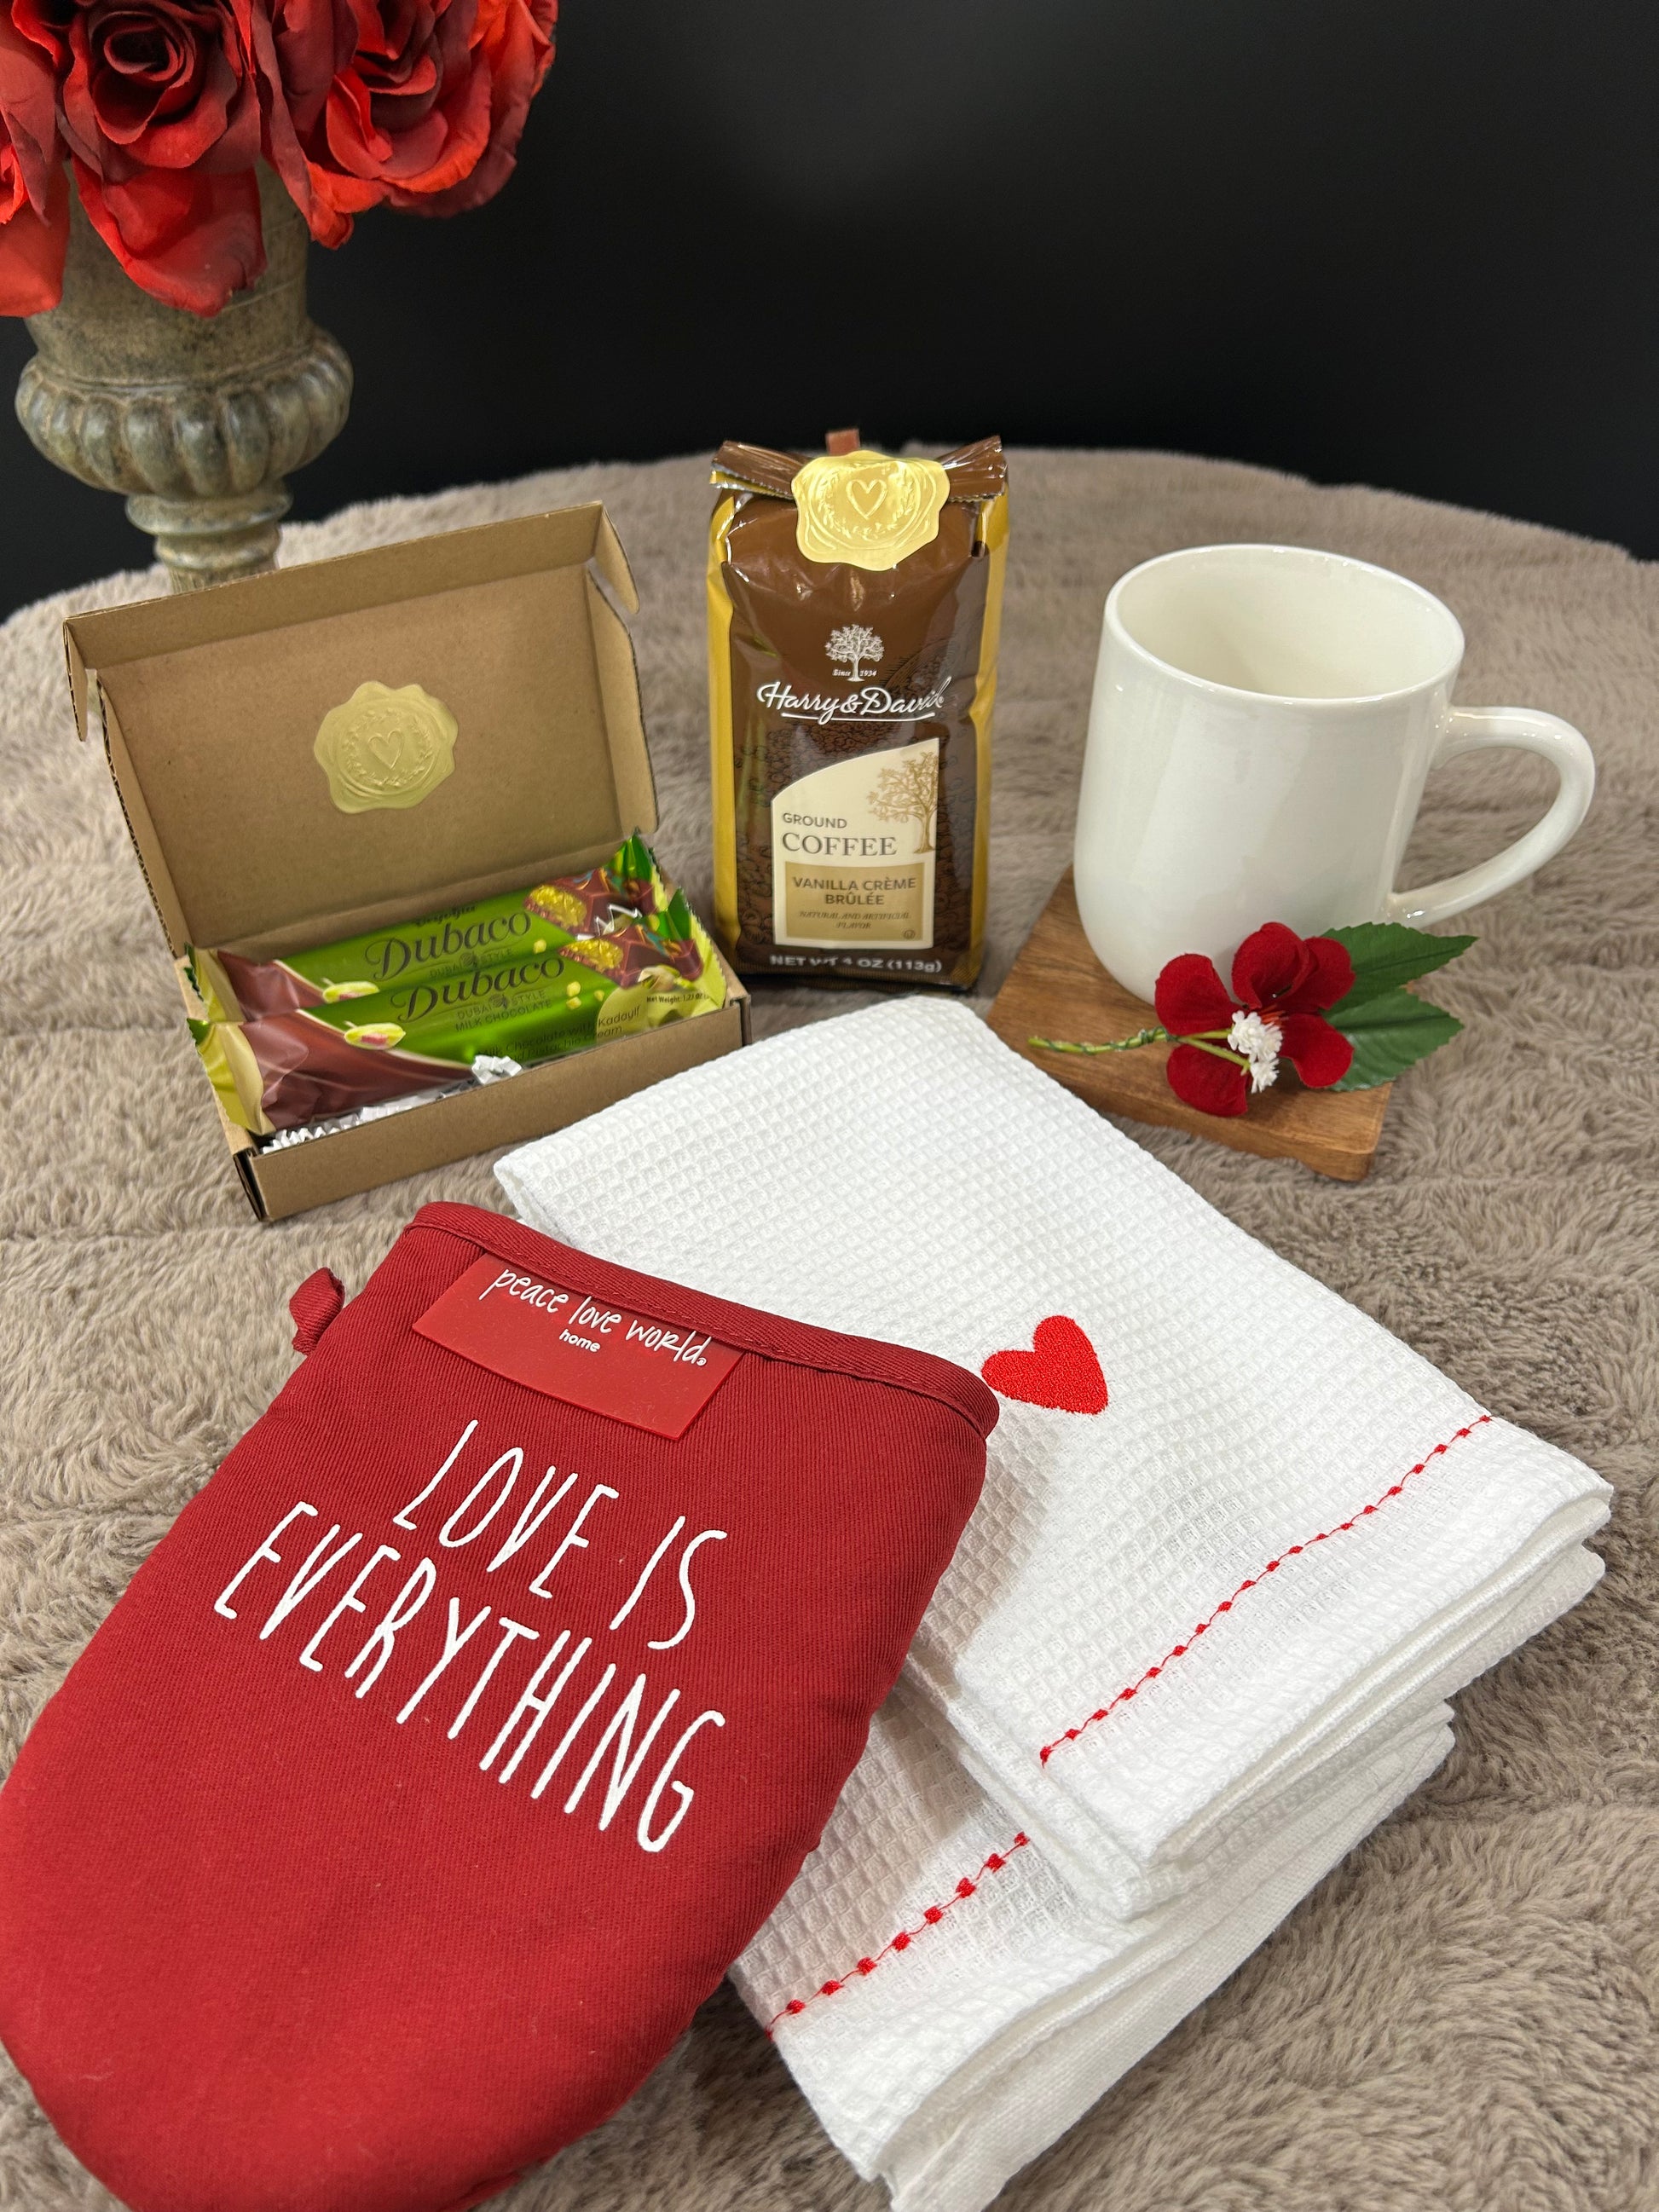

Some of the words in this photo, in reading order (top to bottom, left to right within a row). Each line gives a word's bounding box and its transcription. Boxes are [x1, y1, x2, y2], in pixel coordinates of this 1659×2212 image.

[859, 668, 877, 677] 1934
[783, 812, 847, 829] GROUND
[782, 832, 897, 857] COFFEE
[793, 876, 859, 892] VANILLA
[863, 875, 916, 892] CRÈME
[824, 892, 885, 906] BRÛLÉE
[799, 911, 840, 920] NATURAL
[842, 911, 861, 920] AND
[862, 911, 911, 921] ARTIFICIAL
[365, 912, 531, 981] Dubaco
[770, 955, 806, 967] NET
[842, 956, 853, 965] 4
[857, 957, 884, 968] OZ
[886, 959, 942, 973] (113g)
[390, 958, 564, 1023] Dubaco
[456, 1017, 483, 1032] MILK
[485, 999, 553, 1023] CHOCOLATE
[457, 1002, 492, 1020] DUBAI
[511, 989, 546, 1007] STYLE
[479, 1268, 569, 1313] peace
[569, 1296, 622, 1334] love
[559, 1328, 600, 1352] home
[393, 1419, 619, 1598] LOVE
[610, 1516, 727, 1649] IS
[215, 1501, 725, 1852] EVERYTHING
